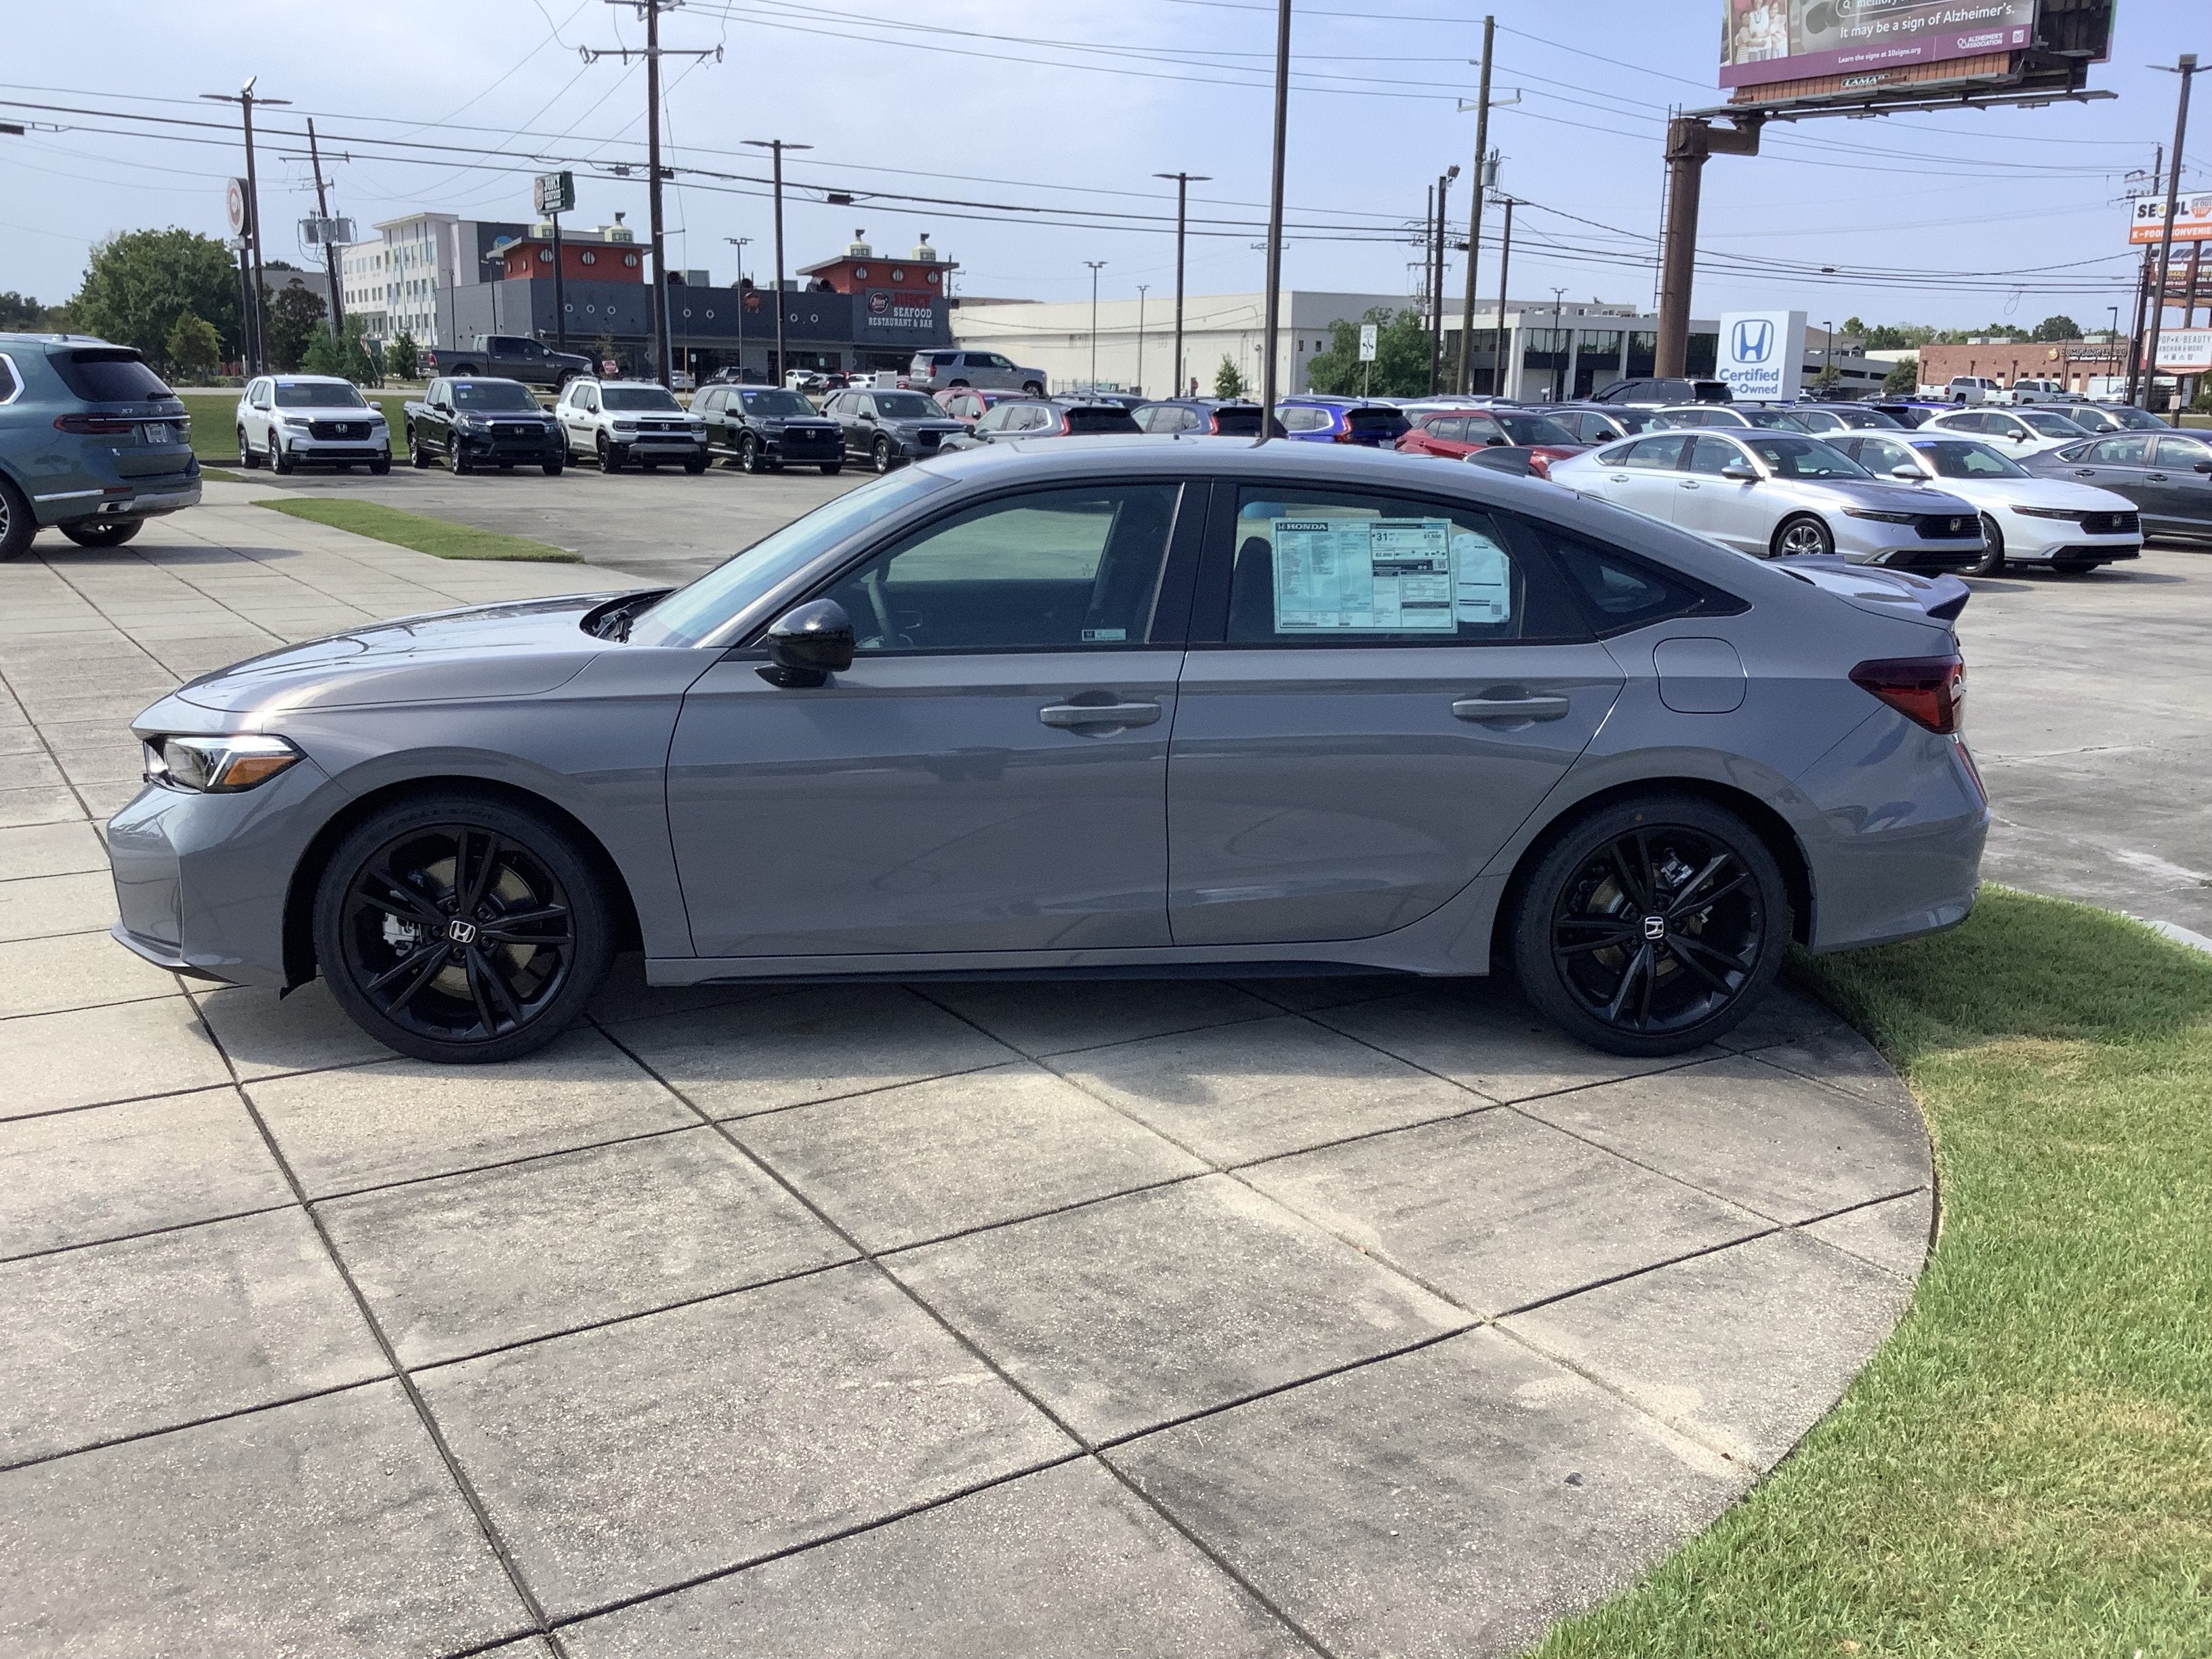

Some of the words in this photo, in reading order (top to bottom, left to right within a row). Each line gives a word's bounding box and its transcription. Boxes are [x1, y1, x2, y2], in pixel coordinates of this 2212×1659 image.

[1840, 26, 1847, 38] It
[1851, 26, 1873, 38] may
[1877, 21, 1889, 33] be
[1893, 22, 1899, 31] a
[1902, 16, 1925, 32] sign
[1928, 12, 1941, 26] of
[1943, 3, 2015, 24] Alzheimer's.
[1966, 39, 2003, 49] ASSOCIATION
[1866, 52, 1880, 61] signs
[1887, 47, 1921, 58] 10signs.org
[544, 174, 560, 191] JUICY
[893, 307, 932, 319] SEAFOOD
[868, 316, 912, 327] RESTAURANT
[913, 319, 918, 327] &
[919, 319, 933, 328] BAR
[1719, 368, 1780, 381] Certified
[1729, 384, 1778, 394] e-Owned
[1376, 532, 1387, 541] 31
